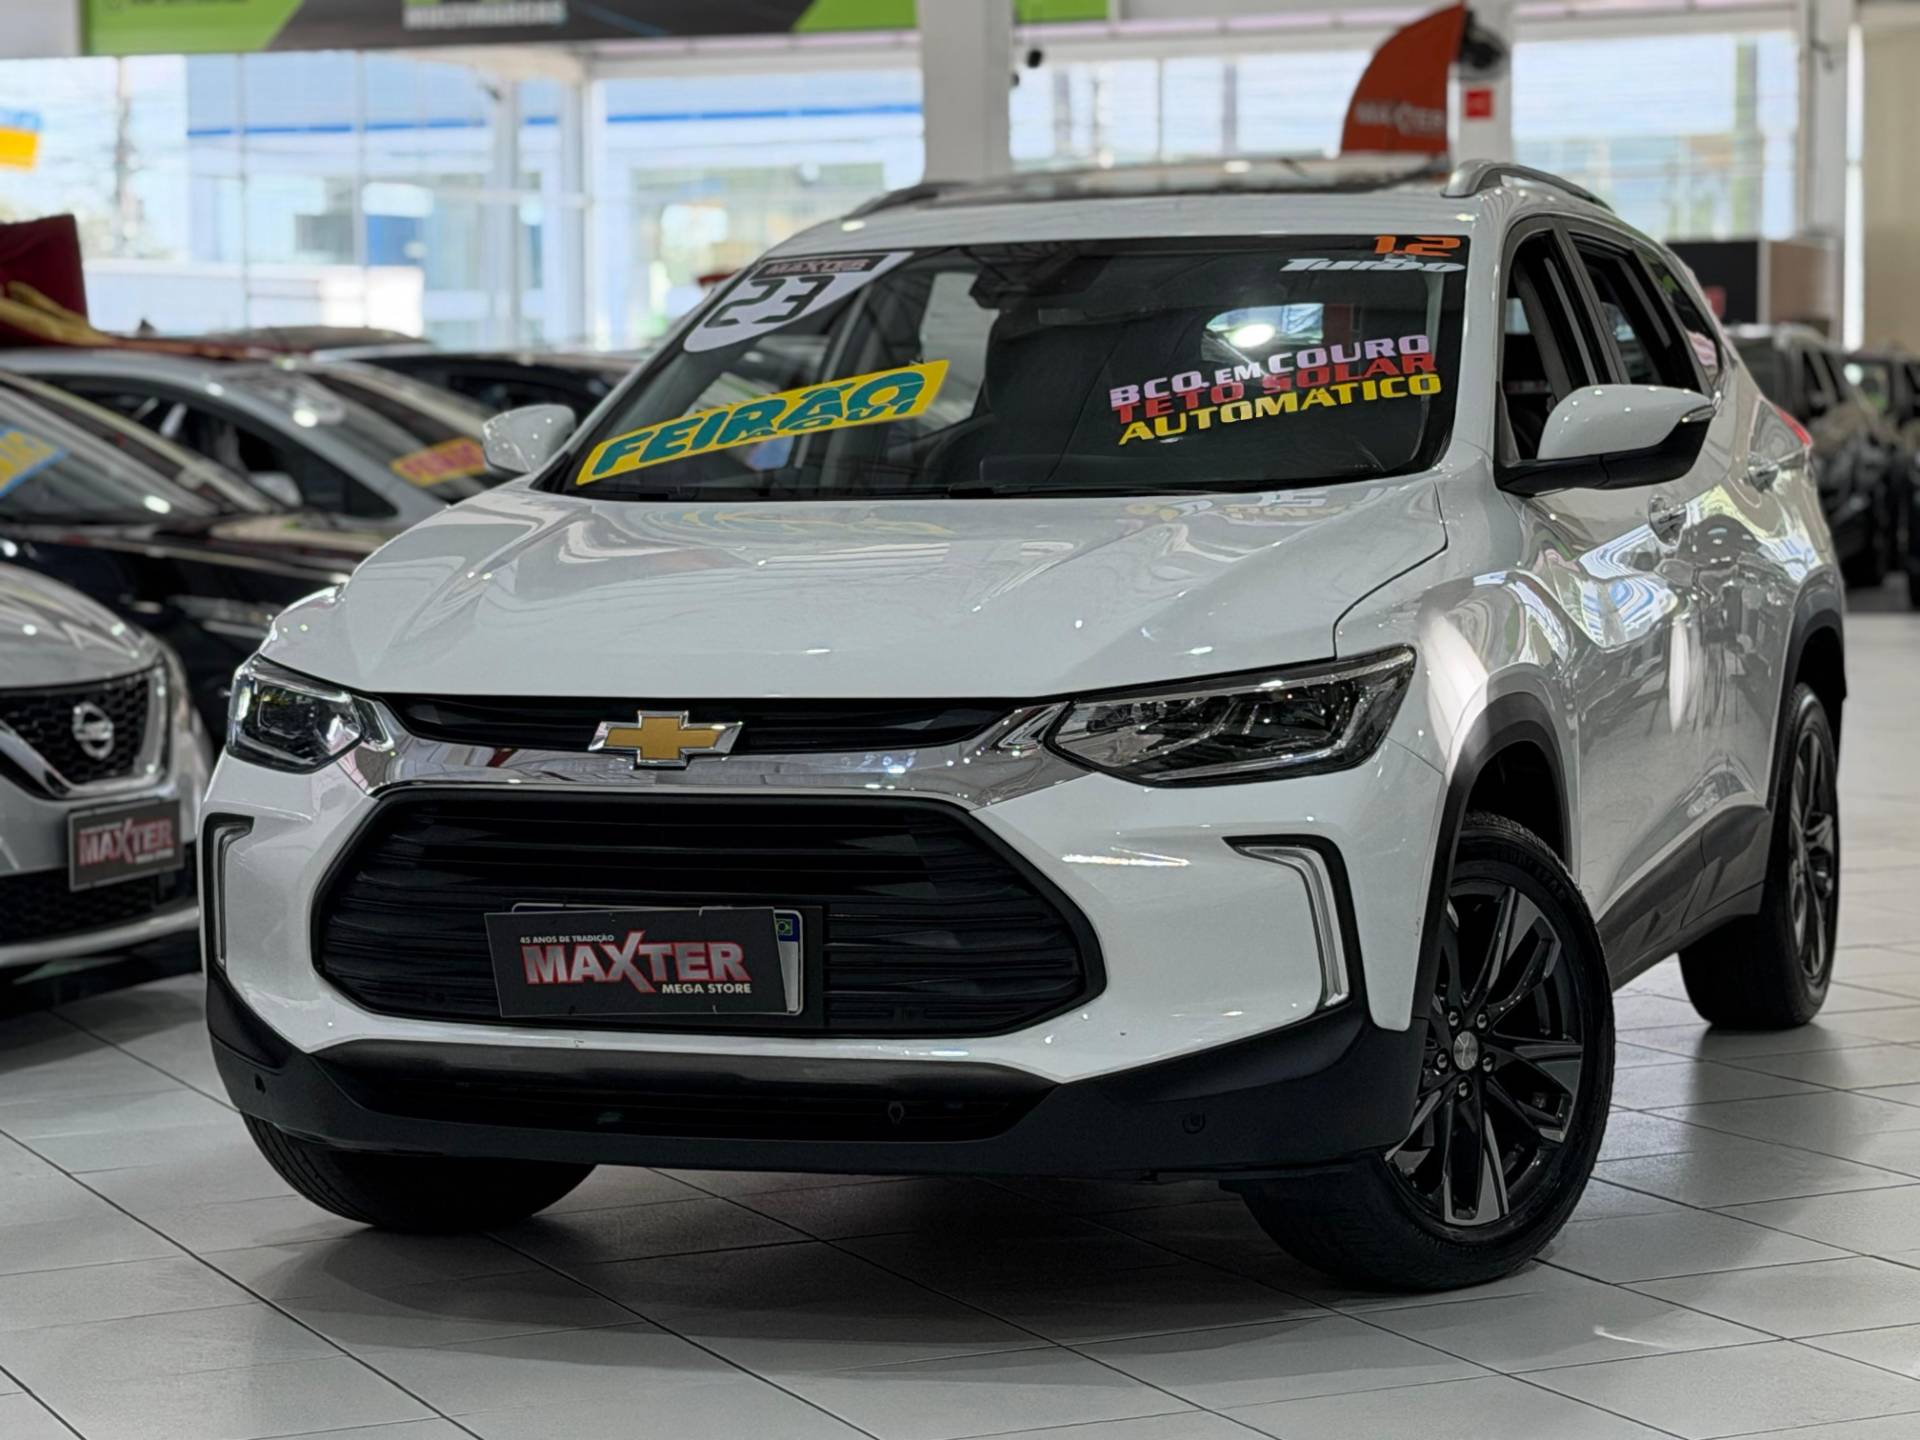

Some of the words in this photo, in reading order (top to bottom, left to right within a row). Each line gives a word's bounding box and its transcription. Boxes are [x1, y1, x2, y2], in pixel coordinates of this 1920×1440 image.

[1374, 234, 1461, 257] 1.2
[703, 275, 836, 328] 23
[1215, 361, 1261, 385] EM
[1268, 334, 1430, 375] COURO
[1112, 381, 1245, 425] TETO
[1262, 353, 1438, 395] SOLAR
[592, 371, 926, 476] FEIRÃO
[79, 819, 173, 865] MAXTER
[521, 930, 752, 994] MAXTER
[532, 936, 557, 944] ANOS
[559, 935, 571, 943] DE
[572, 934, 615, 943] TRADIÇÃO
[661, 984, 704, 994] MEGA
[708, 983, 751, 994] STORE
